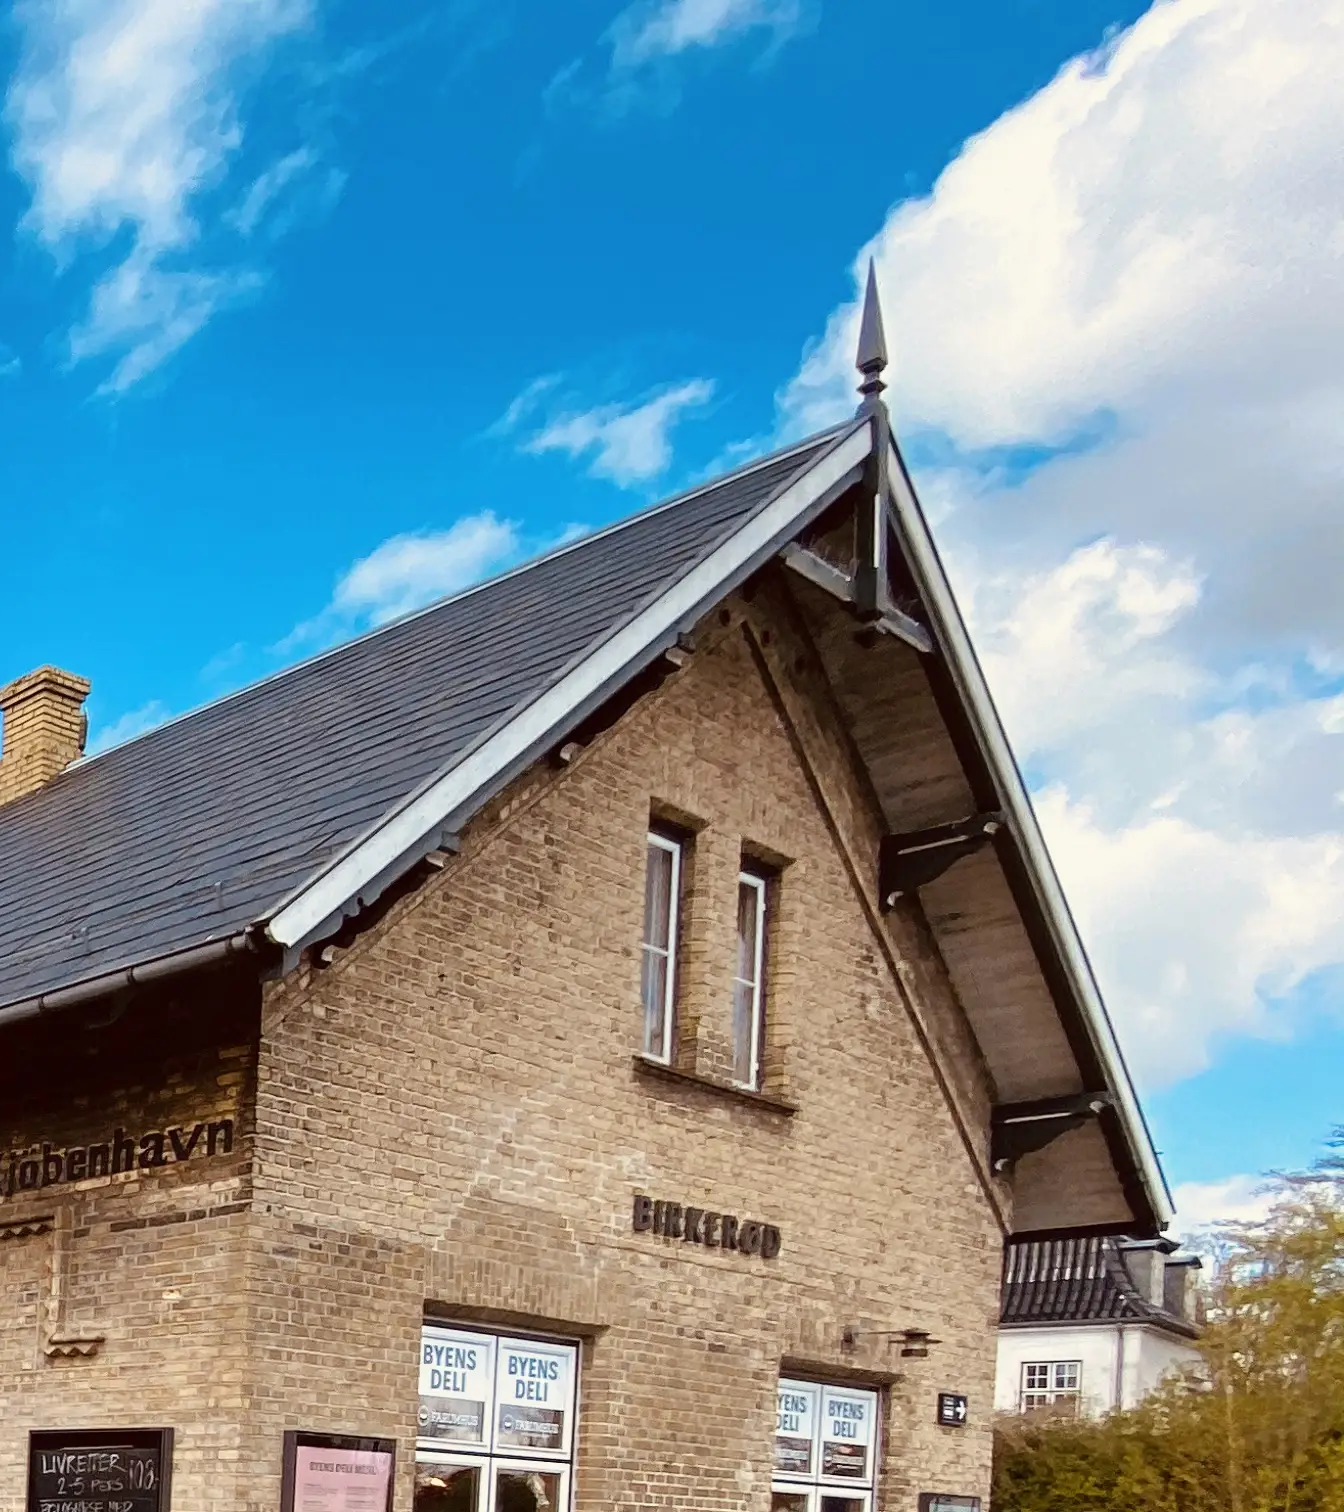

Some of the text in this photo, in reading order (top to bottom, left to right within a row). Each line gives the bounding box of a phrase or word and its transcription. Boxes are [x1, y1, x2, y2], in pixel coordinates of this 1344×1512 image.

[633, 1194, 782, 1258] BIRKERØD
[423, 1344, 477, 1371] BYENS
[508, 1355, 559, 1381] BYENS
[430, 1369, 467, 1392] DELI
[515, 1379, 548, 1402] DELI
[828, 1400, 864, 1421] BYENS
[833, 1420, 857, 1439] DELI
